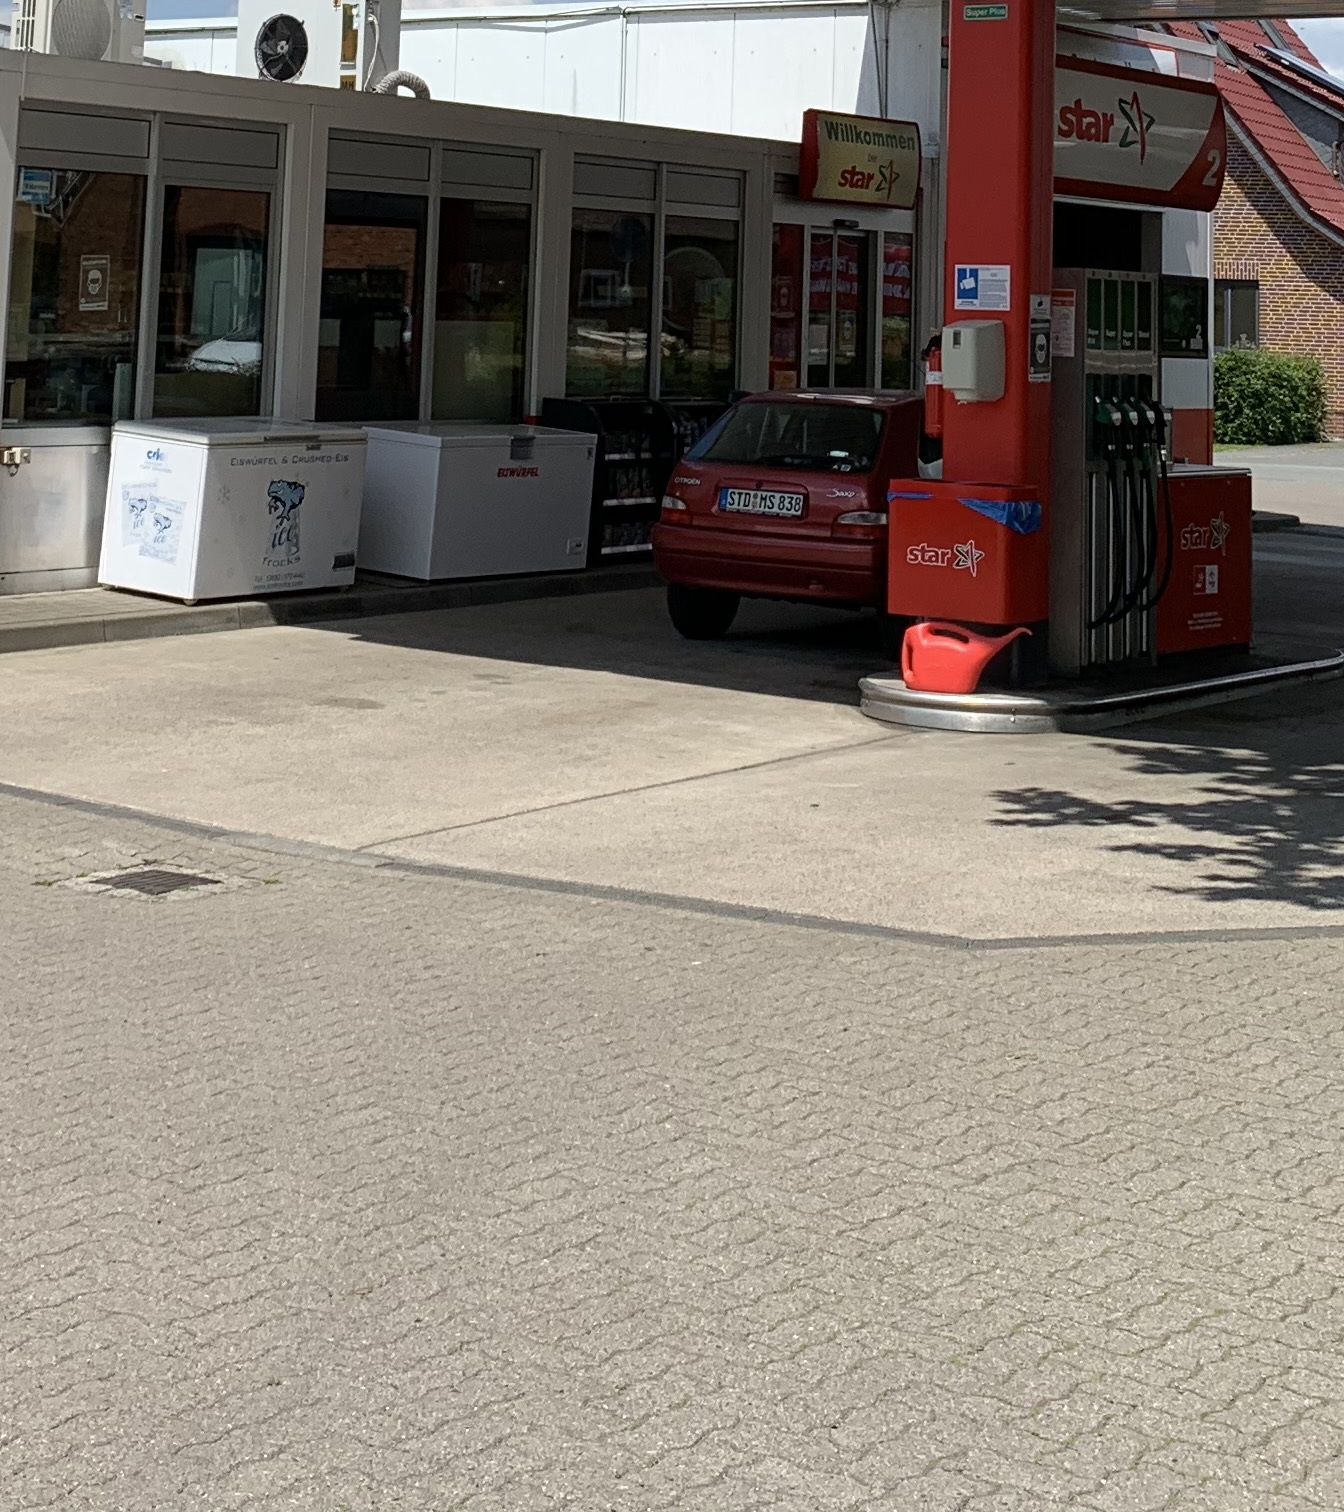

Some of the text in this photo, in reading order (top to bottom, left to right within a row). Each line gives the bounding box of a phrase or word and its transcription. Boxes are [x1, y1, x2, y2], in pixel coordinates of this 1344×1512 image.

[966, 7, 1006, 17] Super Plus
[1057, 97, 1115, 144] star
[824, 120, 916, 151] Willkommen
[838, 165, 875, 190] star
[1202, 149, 1221, 186] 2
[230, 456, 278, 467] EISWÜRFEL
[728, 491, 802, 513] STD MS 838
[1180, 522, 1210, 550] star
[906, 543, 952, 566] star
